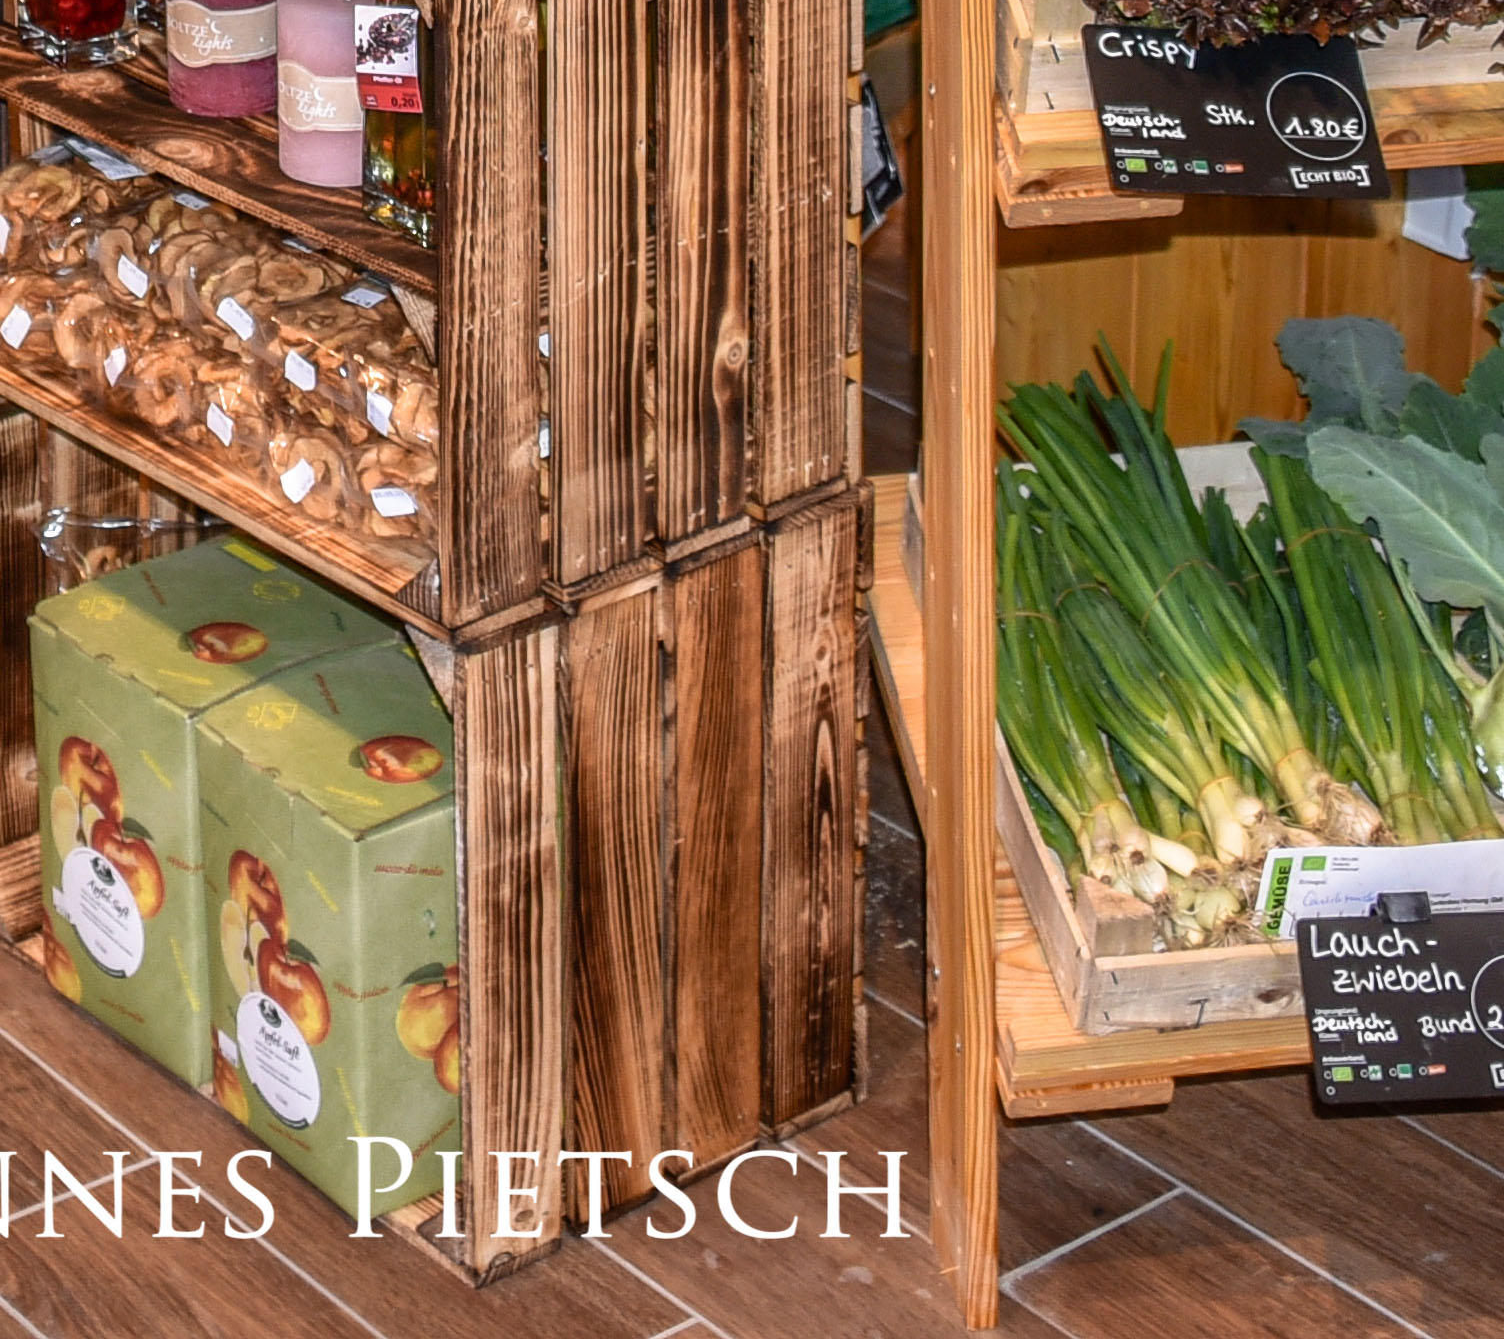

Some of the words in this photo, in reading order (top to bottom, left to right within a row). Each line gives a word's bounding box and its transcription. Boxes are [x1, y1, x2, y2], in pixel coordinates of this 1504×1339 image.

[1098, 31, 1196, 69] Crispy
[1102, 113, 1180, 127] Deutsch-
[1142, 127, 1186, 139] land
[1266, 865, 1292, 930] GEMÜSE
[1312, 1012, 1391, 1032] Deutsch-
[1417, 1011, 1475, 1037] Bund
[1357, 1028, 1398, 1044] land
